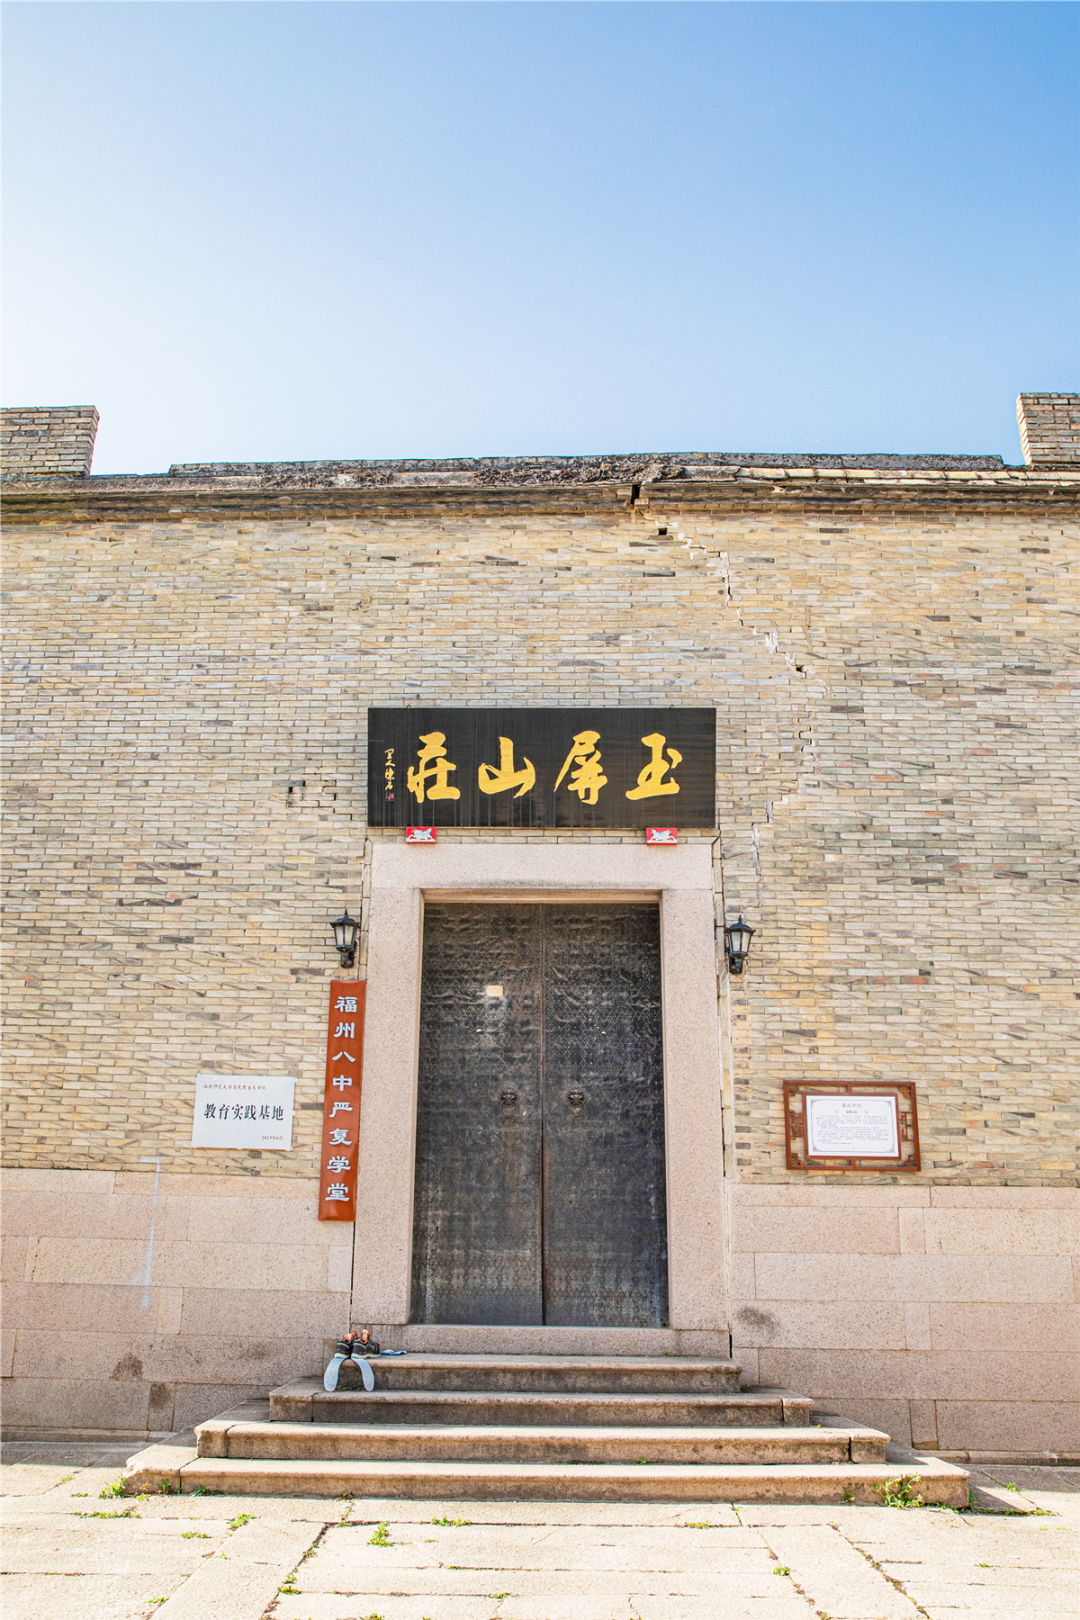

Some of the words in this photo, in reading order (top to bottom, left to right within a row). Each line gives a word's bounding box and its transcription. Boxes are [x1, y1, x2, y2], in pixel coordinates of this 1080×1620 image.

[203, 1102, 284, 1121] 教育实践基地
[325, 995, 358, 1202] 福州八中严复学堂
